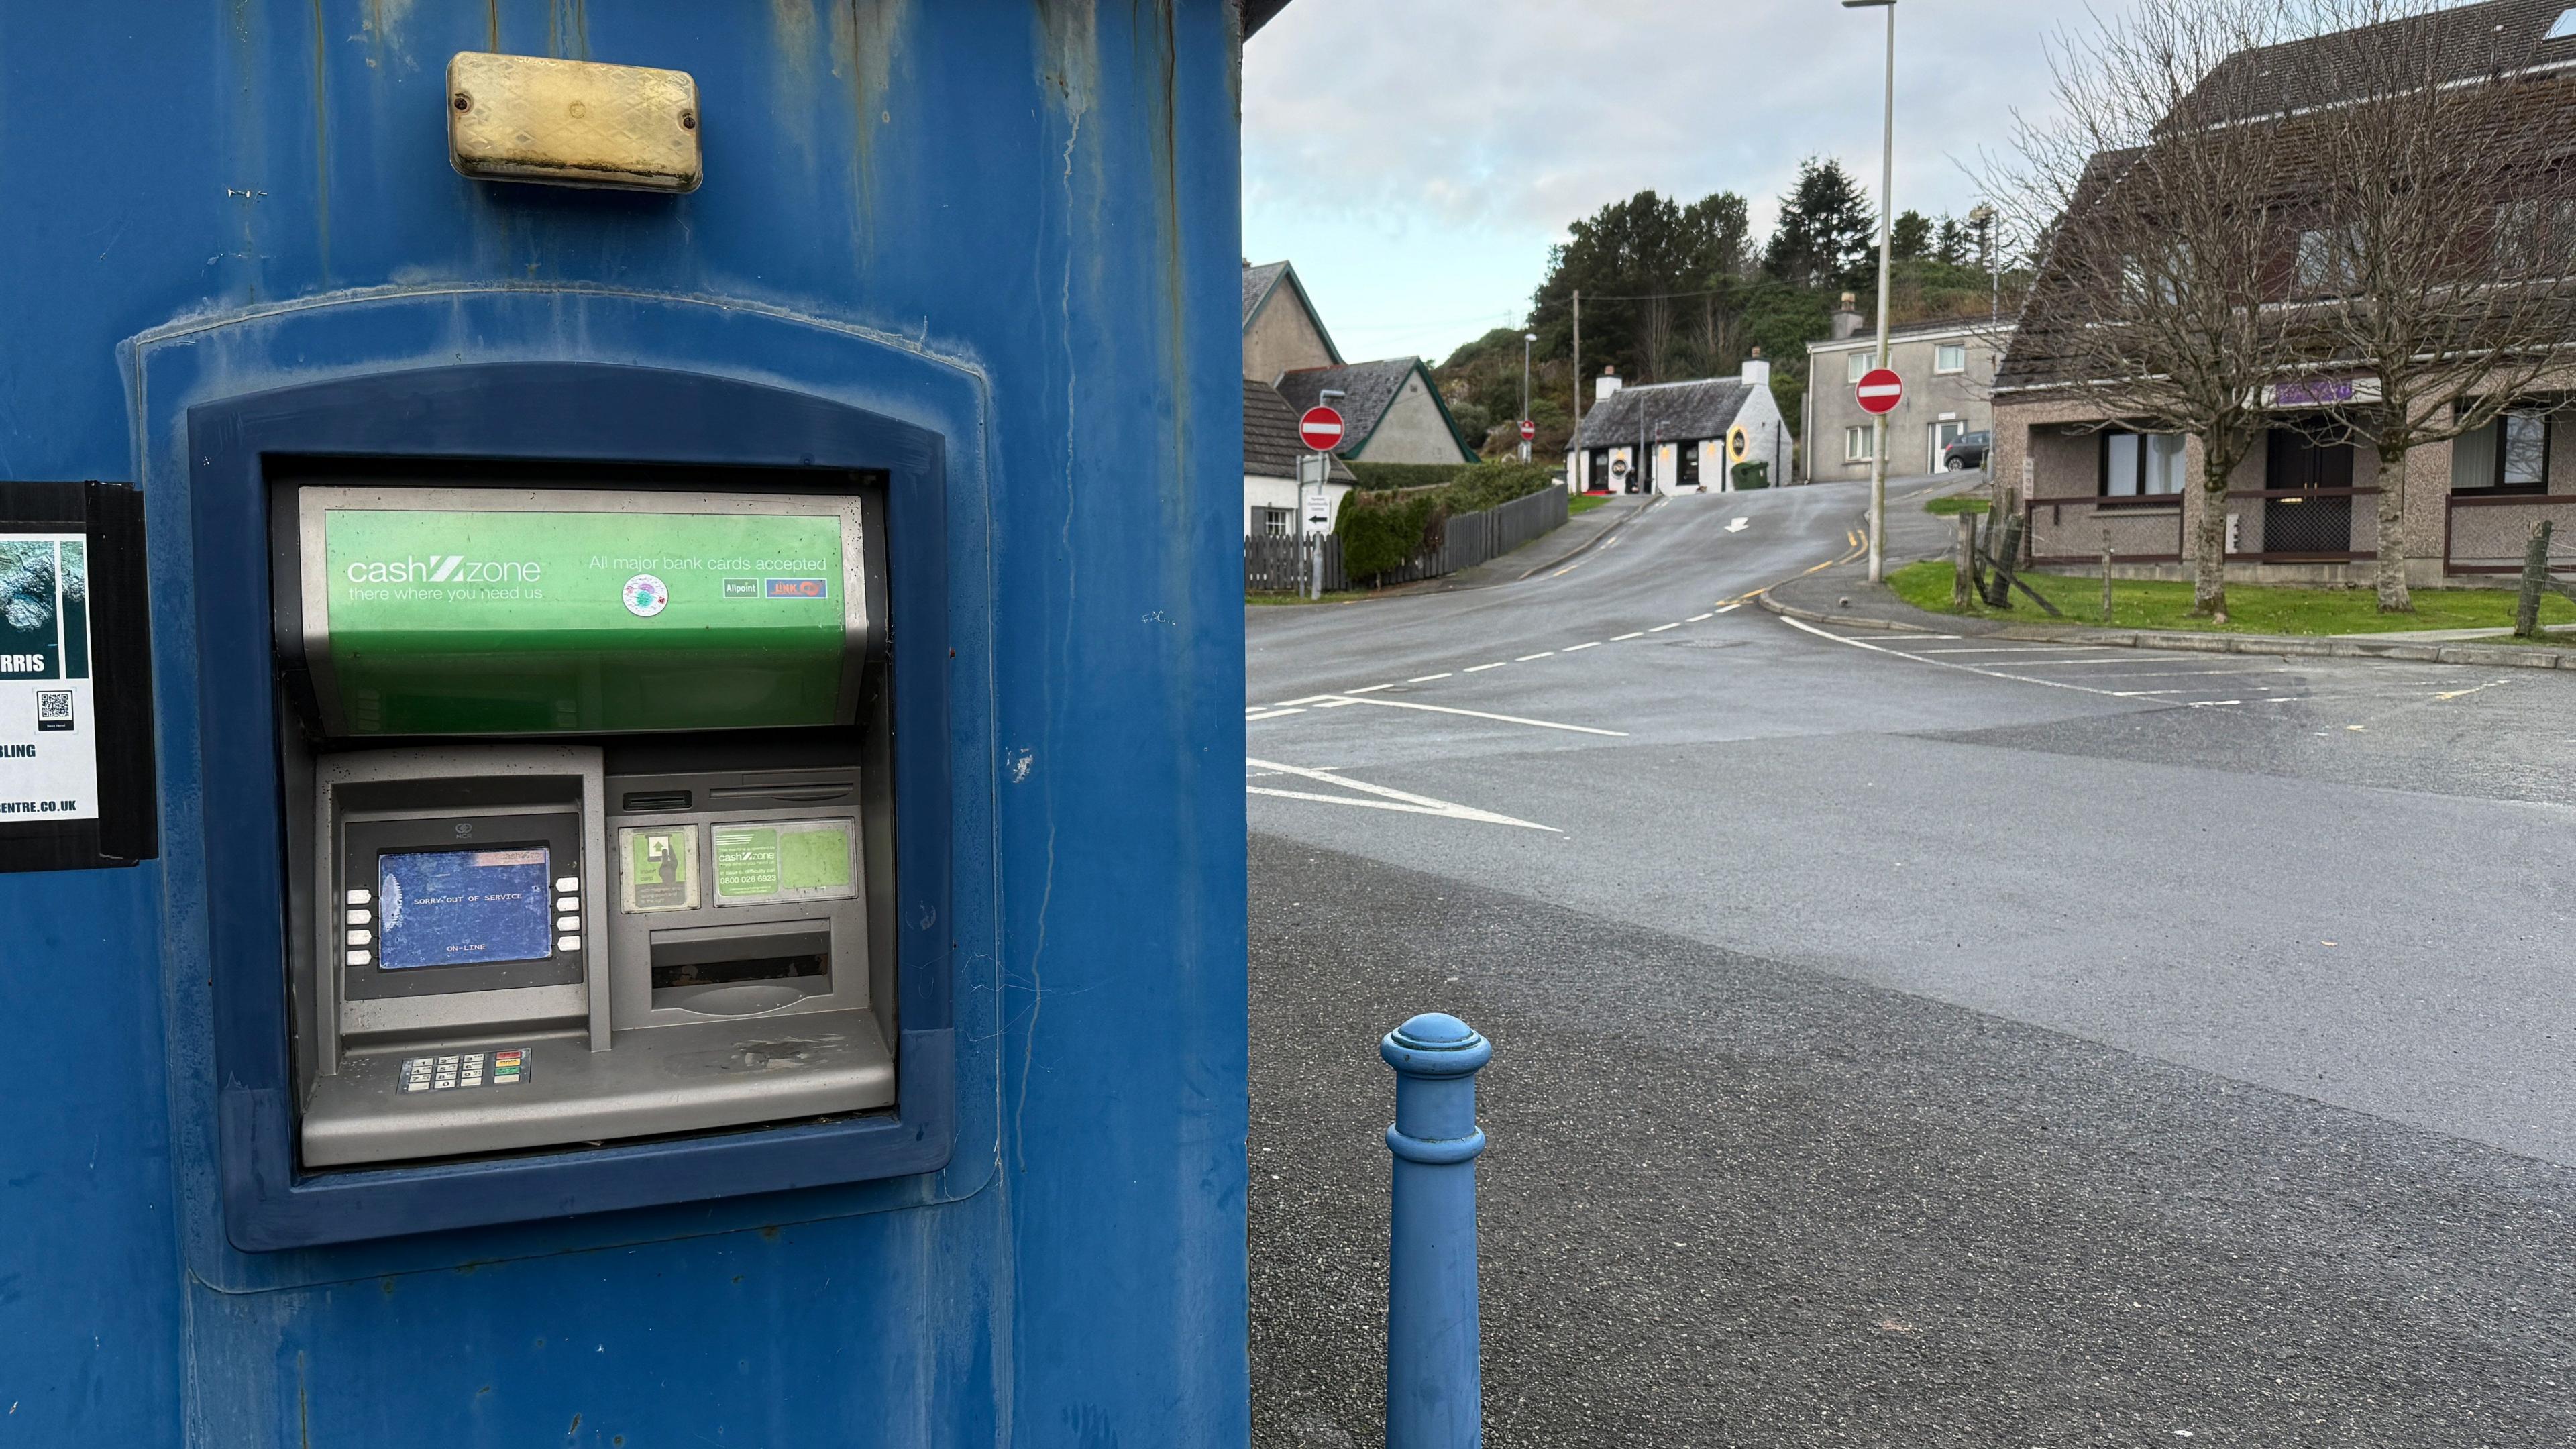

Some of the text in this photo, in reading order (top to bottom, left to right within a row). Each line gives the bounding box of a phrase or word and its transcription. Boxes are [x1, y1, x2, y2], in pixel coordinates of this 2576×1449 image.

[347, 555, 541, 582] cash zone
[590, 556, 826, 573] All major bank cards accepted
[726, 582, 756, 593] Allpoint
[349, 587, 543, 602] there where you need us
[0, 800, 76, 813] ENTRE.CO.UK
[718, 852, 775, 862] cash zone
[720, 875, 777, 885] 0800 028 6923
[484, 893, 523, 901] SERVICE
[447, 944, 486, 952] ON-LINE
